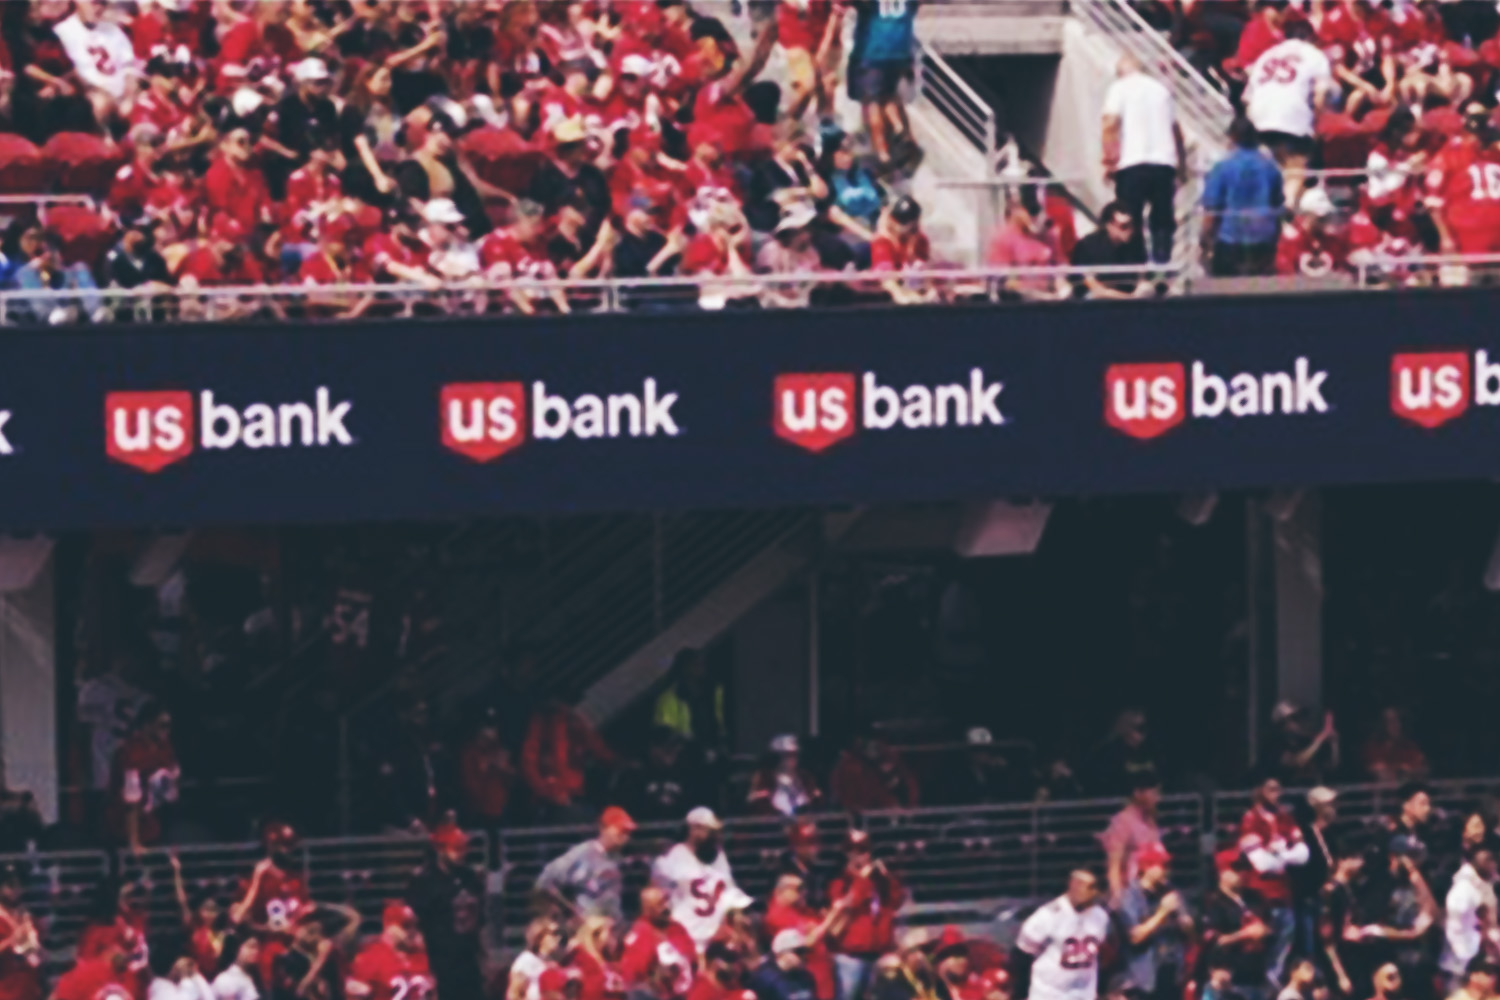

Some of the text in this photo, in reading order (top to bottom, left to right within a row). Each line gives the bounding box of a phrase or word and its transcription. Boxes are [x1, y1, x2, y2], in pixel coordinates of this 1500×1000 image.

[113, 386, 353, 452] us bank
[448, 377, 679, 442] us bank
[781, 367, 1005, 432] us bank
[1112, 356, 1328, 421] us bank
[1399, 364, 1463, 410] us
